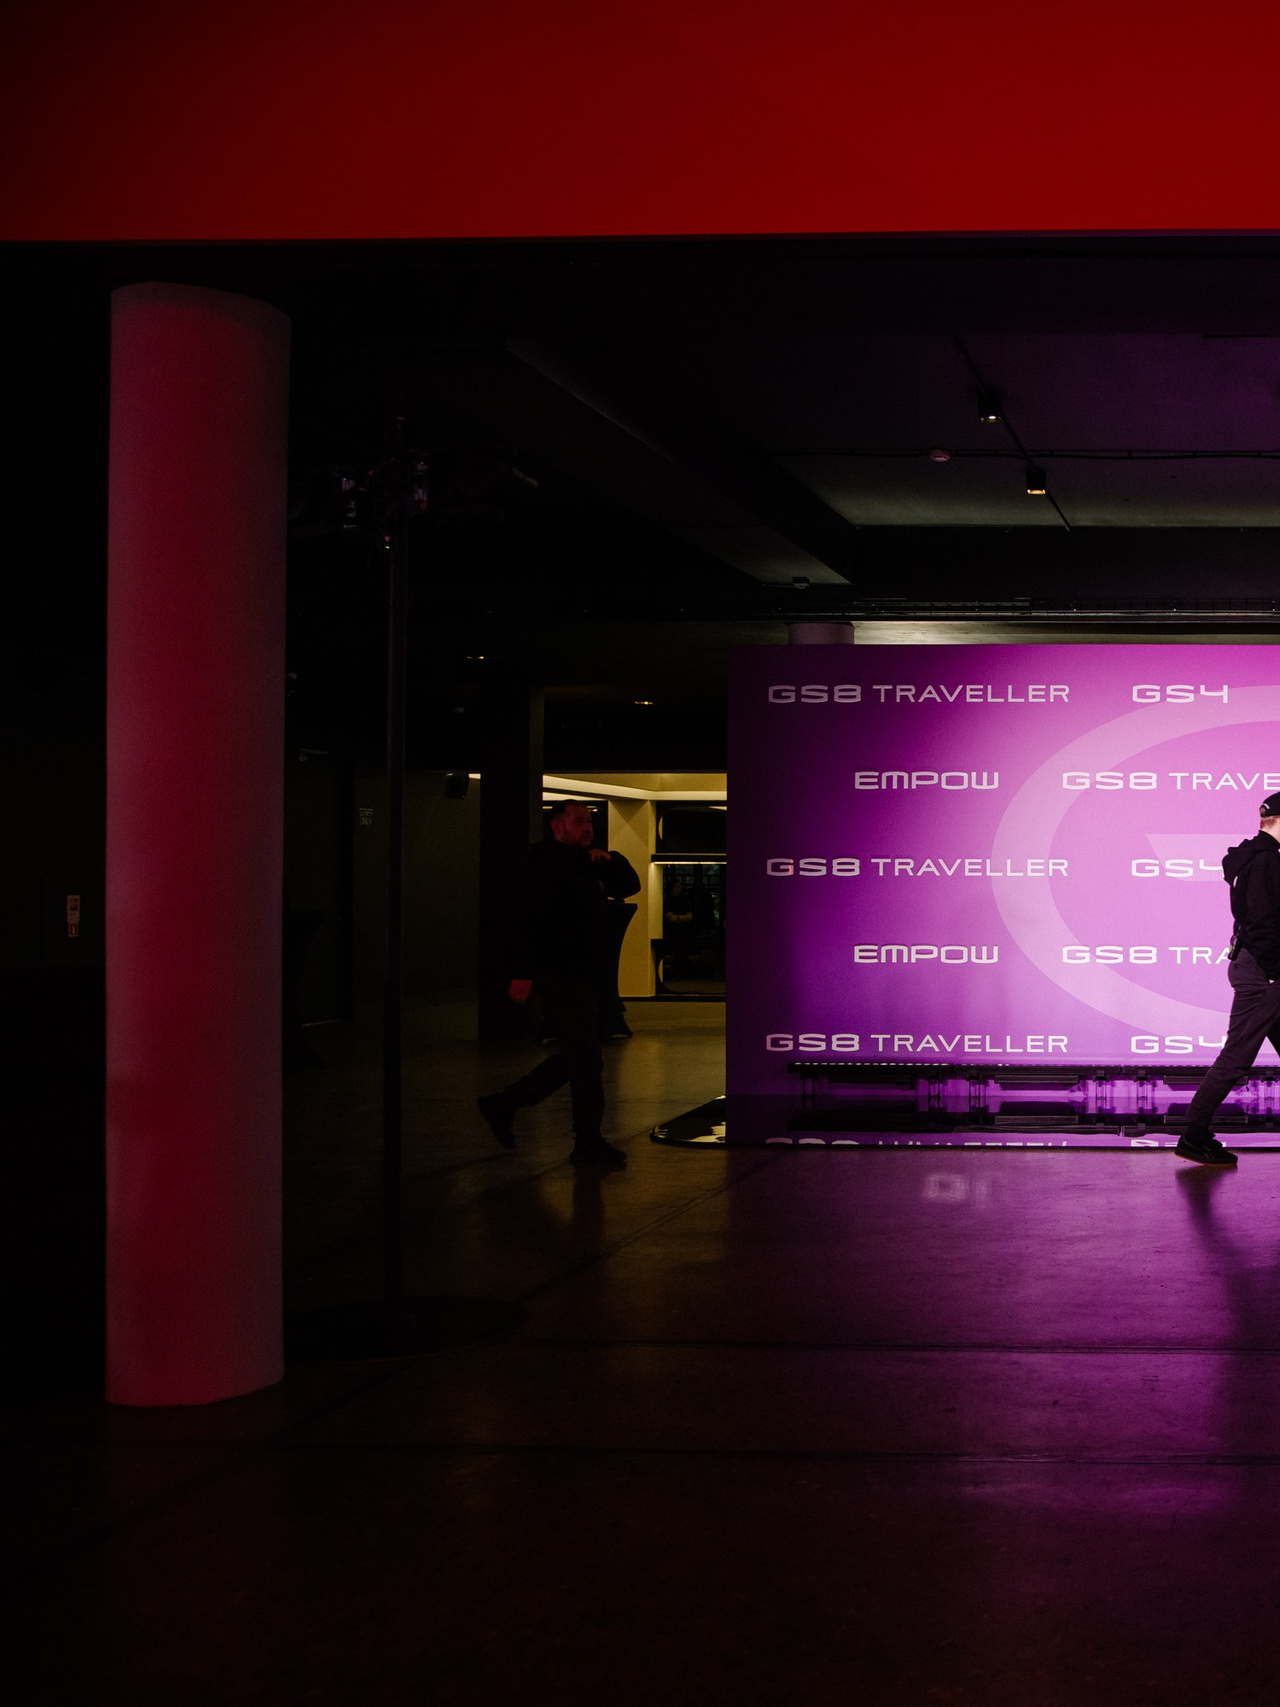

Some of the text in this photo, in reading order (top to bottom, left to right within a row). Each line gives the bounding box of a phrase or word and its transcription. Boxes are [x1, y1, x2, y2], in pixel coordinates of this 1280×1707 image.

[768, 684, 1070, 703] GS8 TRAVELLER
[1132, 684, 1228, 704] GS4
[854, 771, 999, 790] EMPOW
[1062, 771, 1157, 791] GS8
[766, 857, 1069, 877] GS8 TRAVELLER
[854, 945, 999, 964] EMPOW
[1062, 945, 1157, 965] GS8
[766, 1033, 1068, 1053] GS8 TRAVELLER
